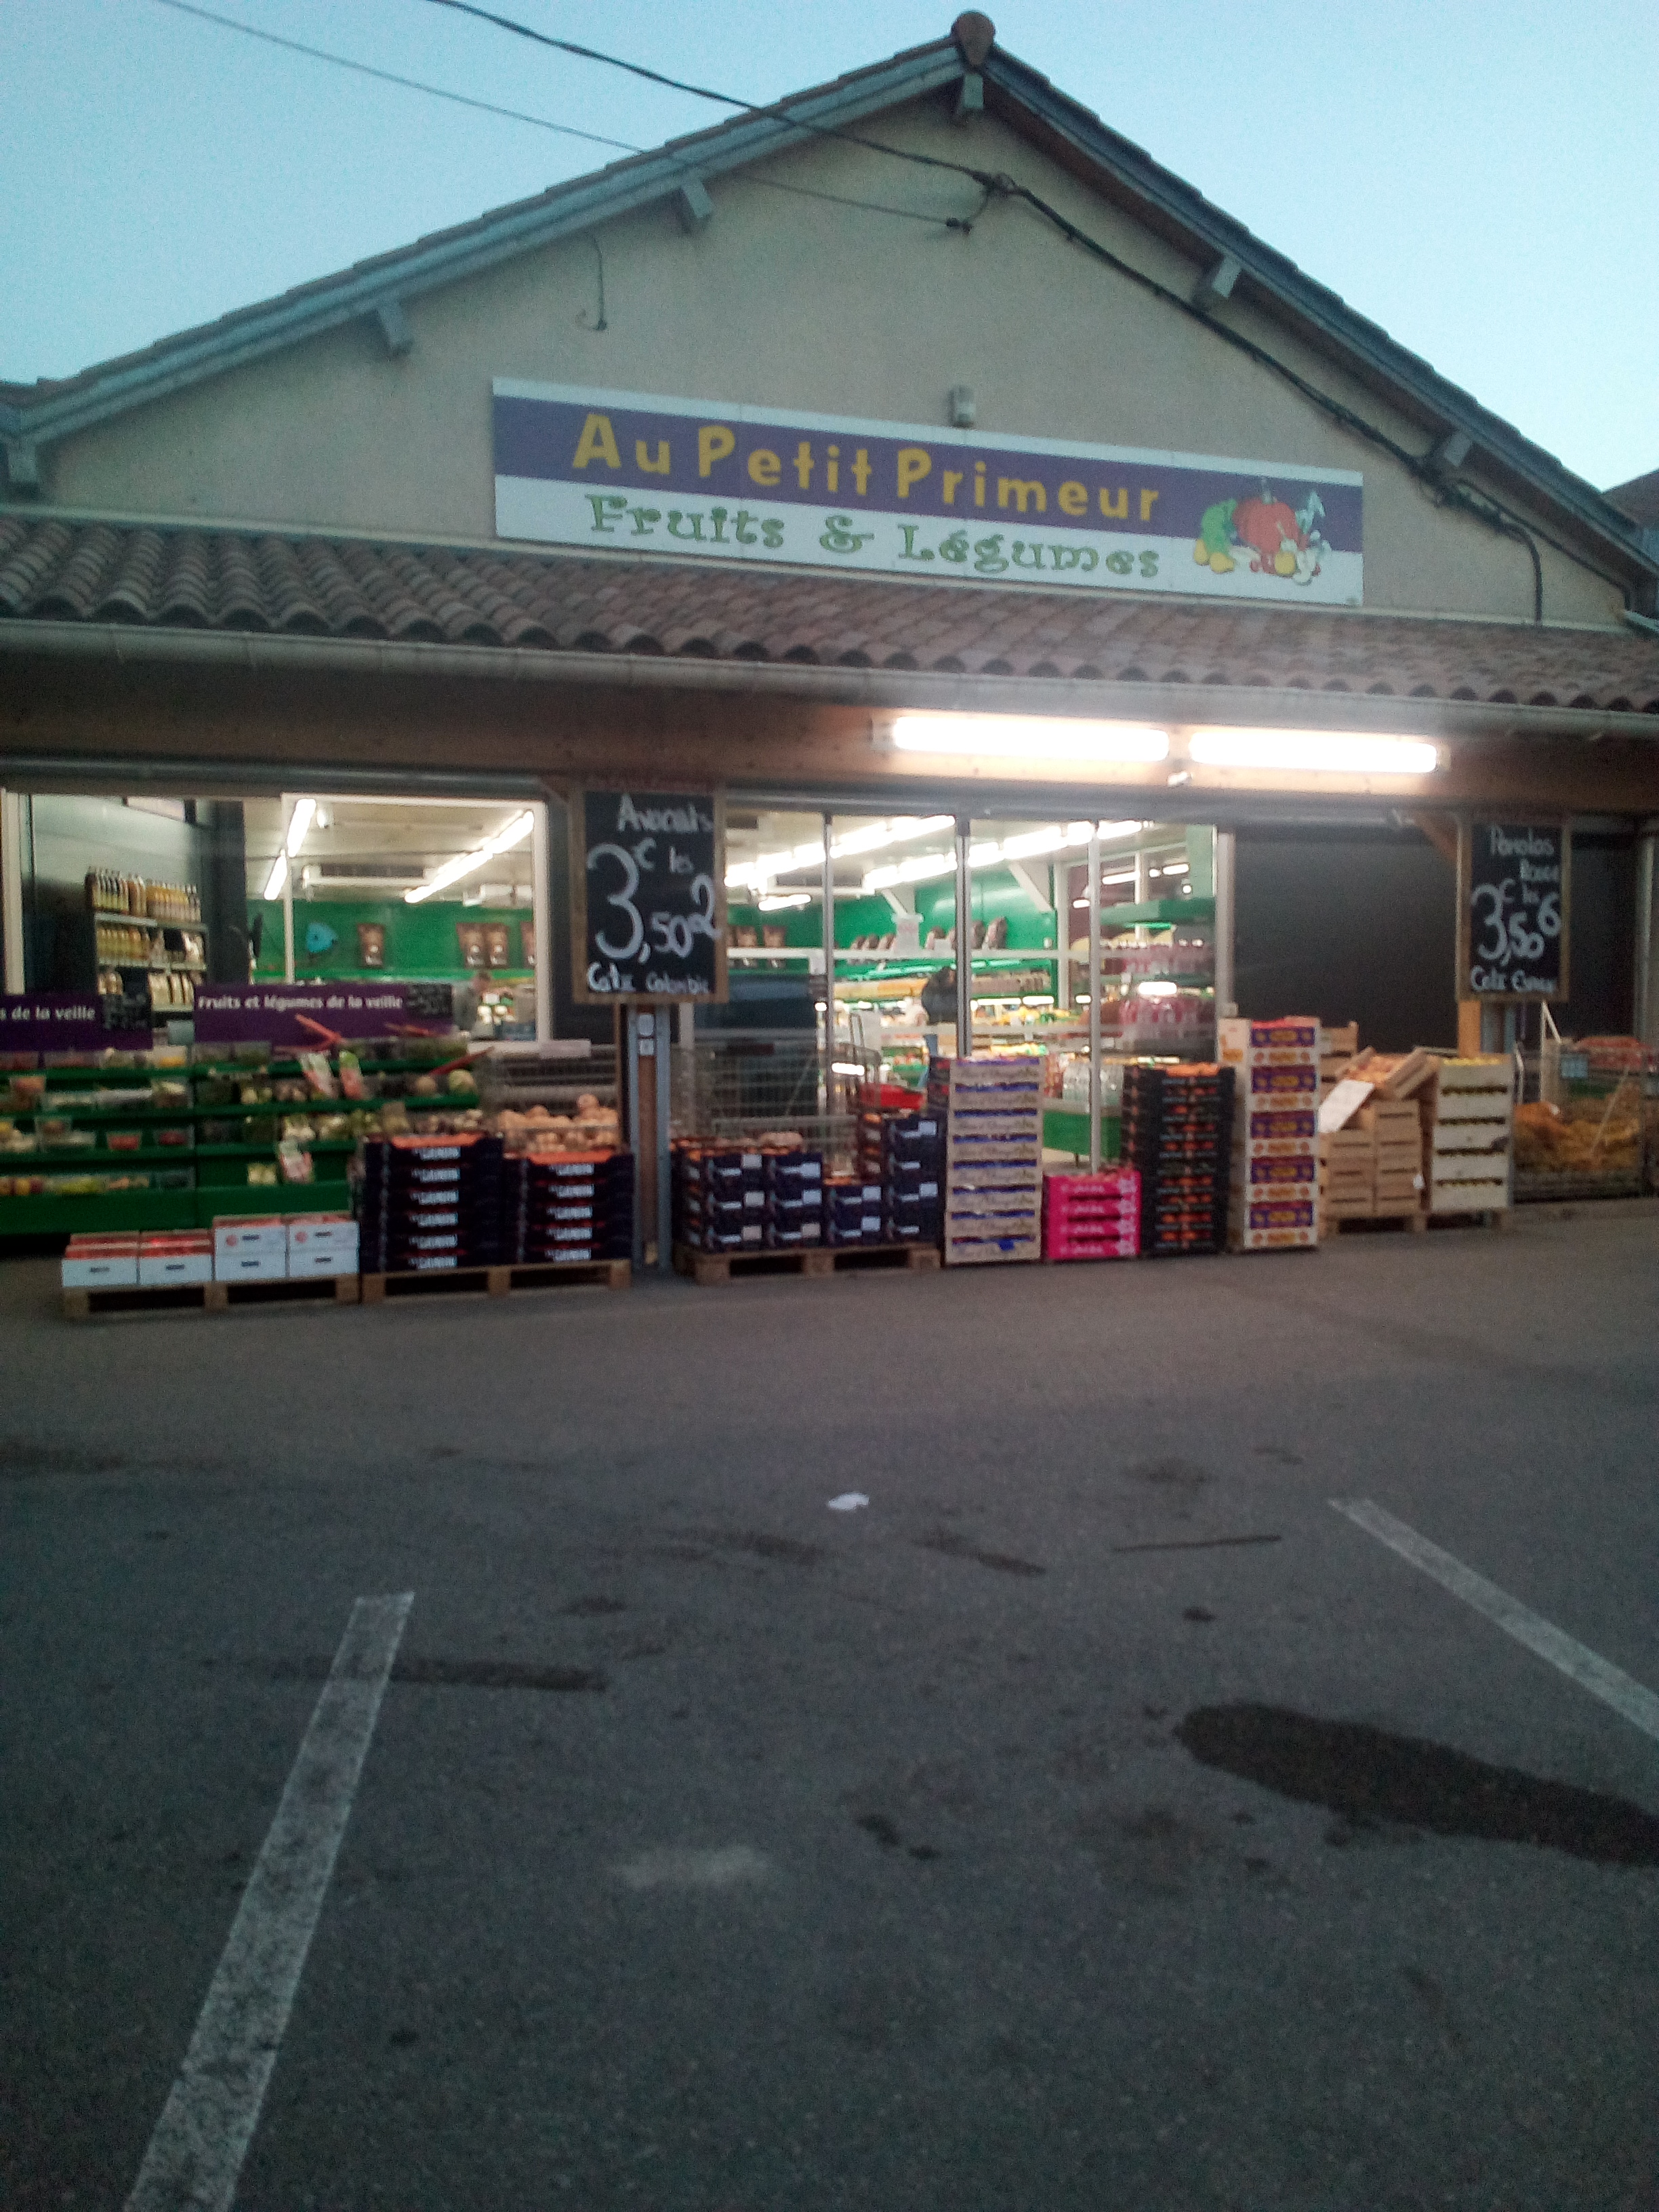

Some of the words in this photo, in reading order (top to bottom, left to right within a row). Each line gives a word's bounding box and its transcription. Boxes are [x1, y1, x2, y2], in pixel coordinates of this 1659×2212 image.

[573, 413, 671, 474] Au
[698, 425, 872, 495] Petit
[897, 448, 1159, 521] Primeur
[586, 494, 784, 548] Fruits
[819, 515, 874, 554] &
[898, 525, 1160, 578] Légumes
[12, 1006, 30, 1020] de
[35, 1006, 51, 1020] la
[55, 1006, 96, 1021] veille
[199, 996, 241, 1009] Fruits
[245, 996, 259, 1009] et
[264, 994, 323, 1012] légumes
[327, 995, 346, 1009] de
[348, 995, 363, 1009] la
[365, 995, 403, 1009] veille
